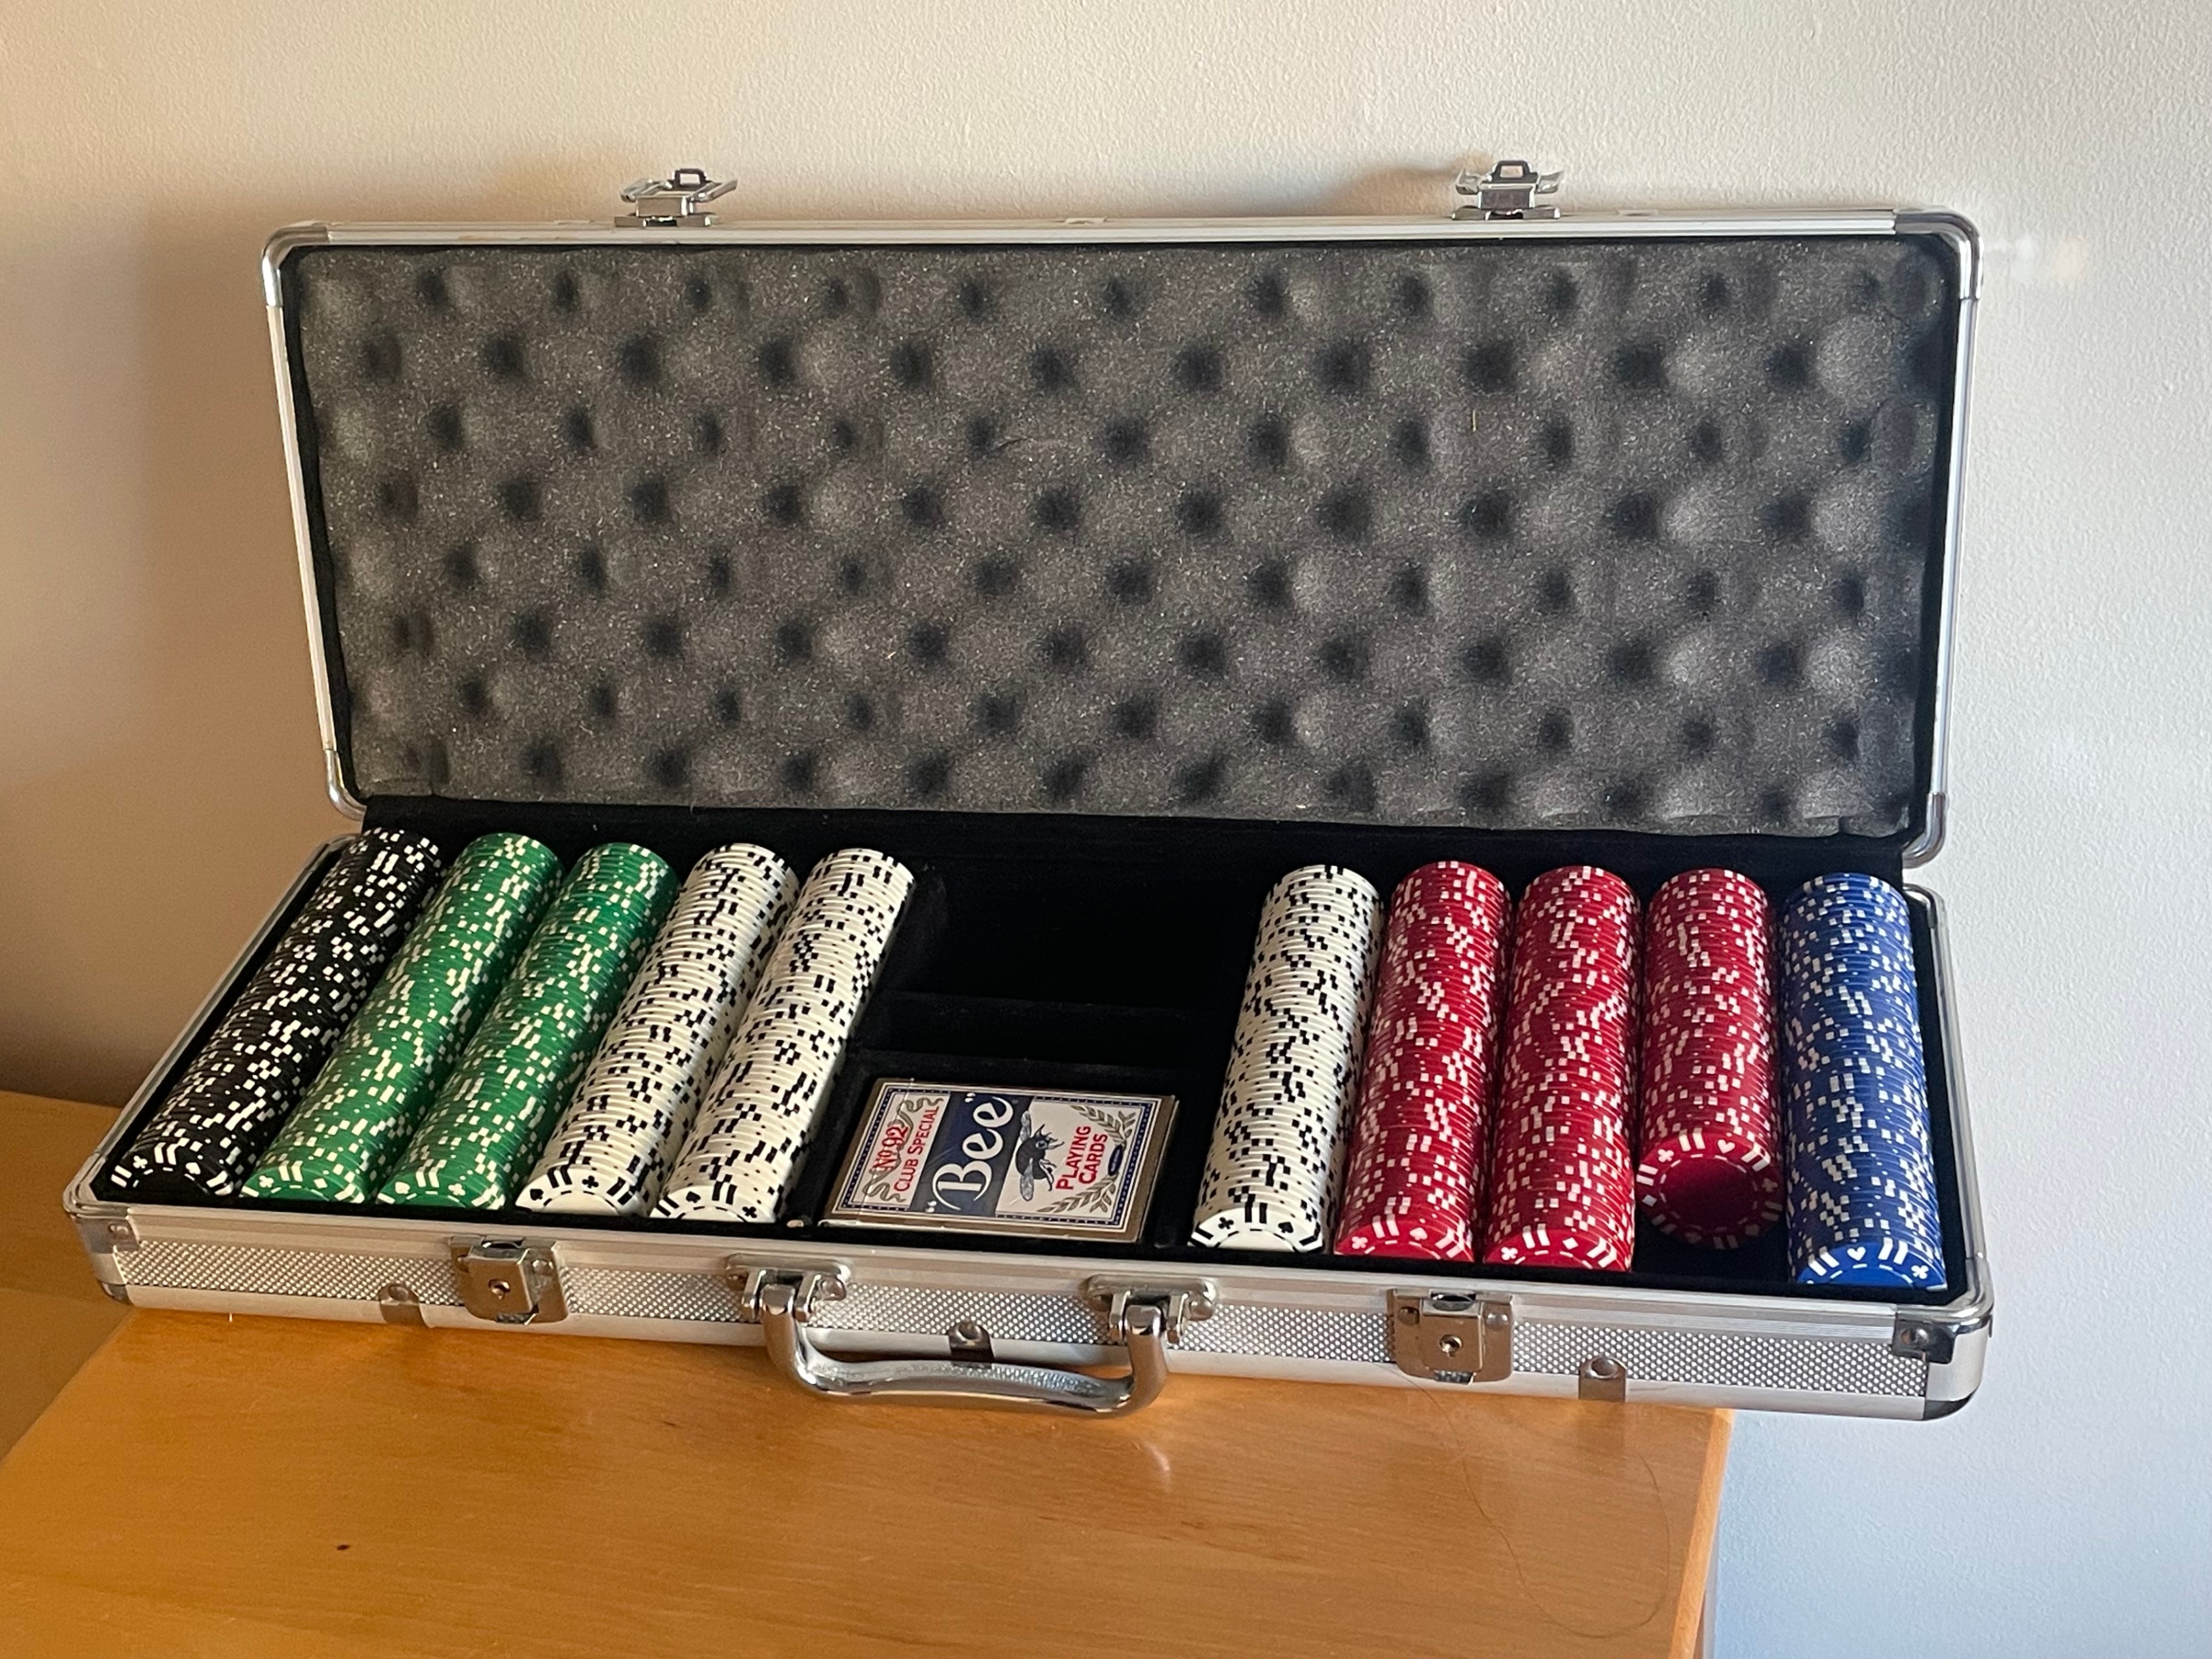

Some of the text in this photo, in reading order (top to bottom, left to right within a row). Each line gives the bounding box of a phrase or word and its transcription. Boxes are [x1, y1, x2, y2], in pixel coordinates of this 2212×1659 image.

[882, 1126, 908, 1148] 92
[894, 1106, 939, 1191] CLUB SPECIAL
[1056, 1126, 1091, 1190] PLAYING
[1079, 1134, 1108, 1184] CARDS
